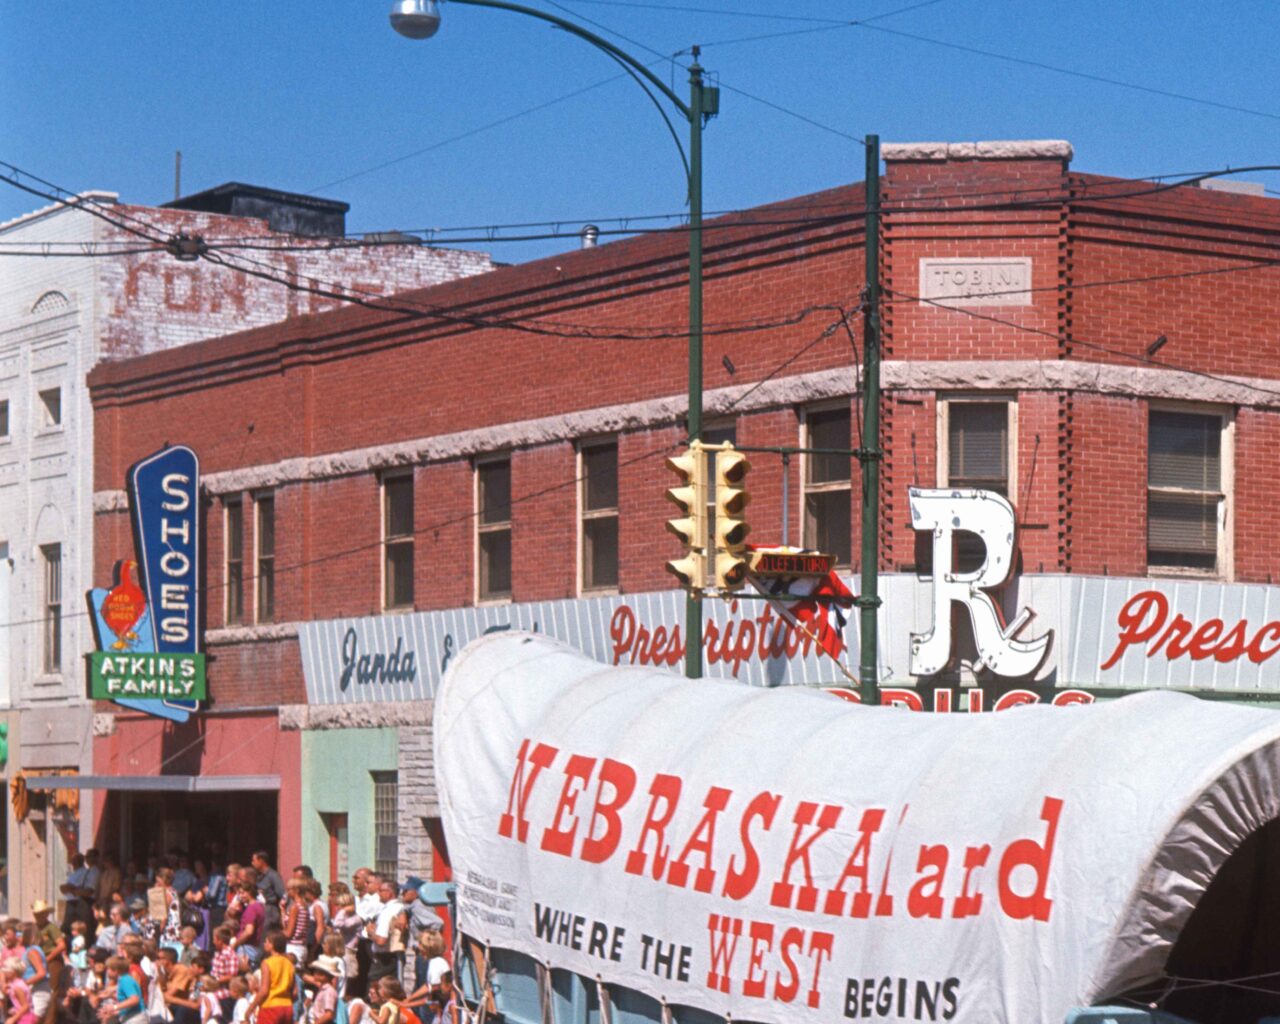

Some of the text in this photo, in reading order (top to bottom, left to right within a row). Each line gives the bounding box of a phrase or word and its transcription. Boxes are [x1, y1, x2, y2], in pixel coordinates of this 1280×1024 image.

[160, 473, 190, 643] SHOES
[771, 557, 797, 574] LEFT
[101, 657, 195, 676] ATKINS
[340, 627, 416, 692] Janda
[610, 599, 848, 678] Presription
[107, 679, 194, 694] FAMILY
[534, 902, 693, 982] WHERE THE
[706, 914, 961, 1021] WEST BEGINS
